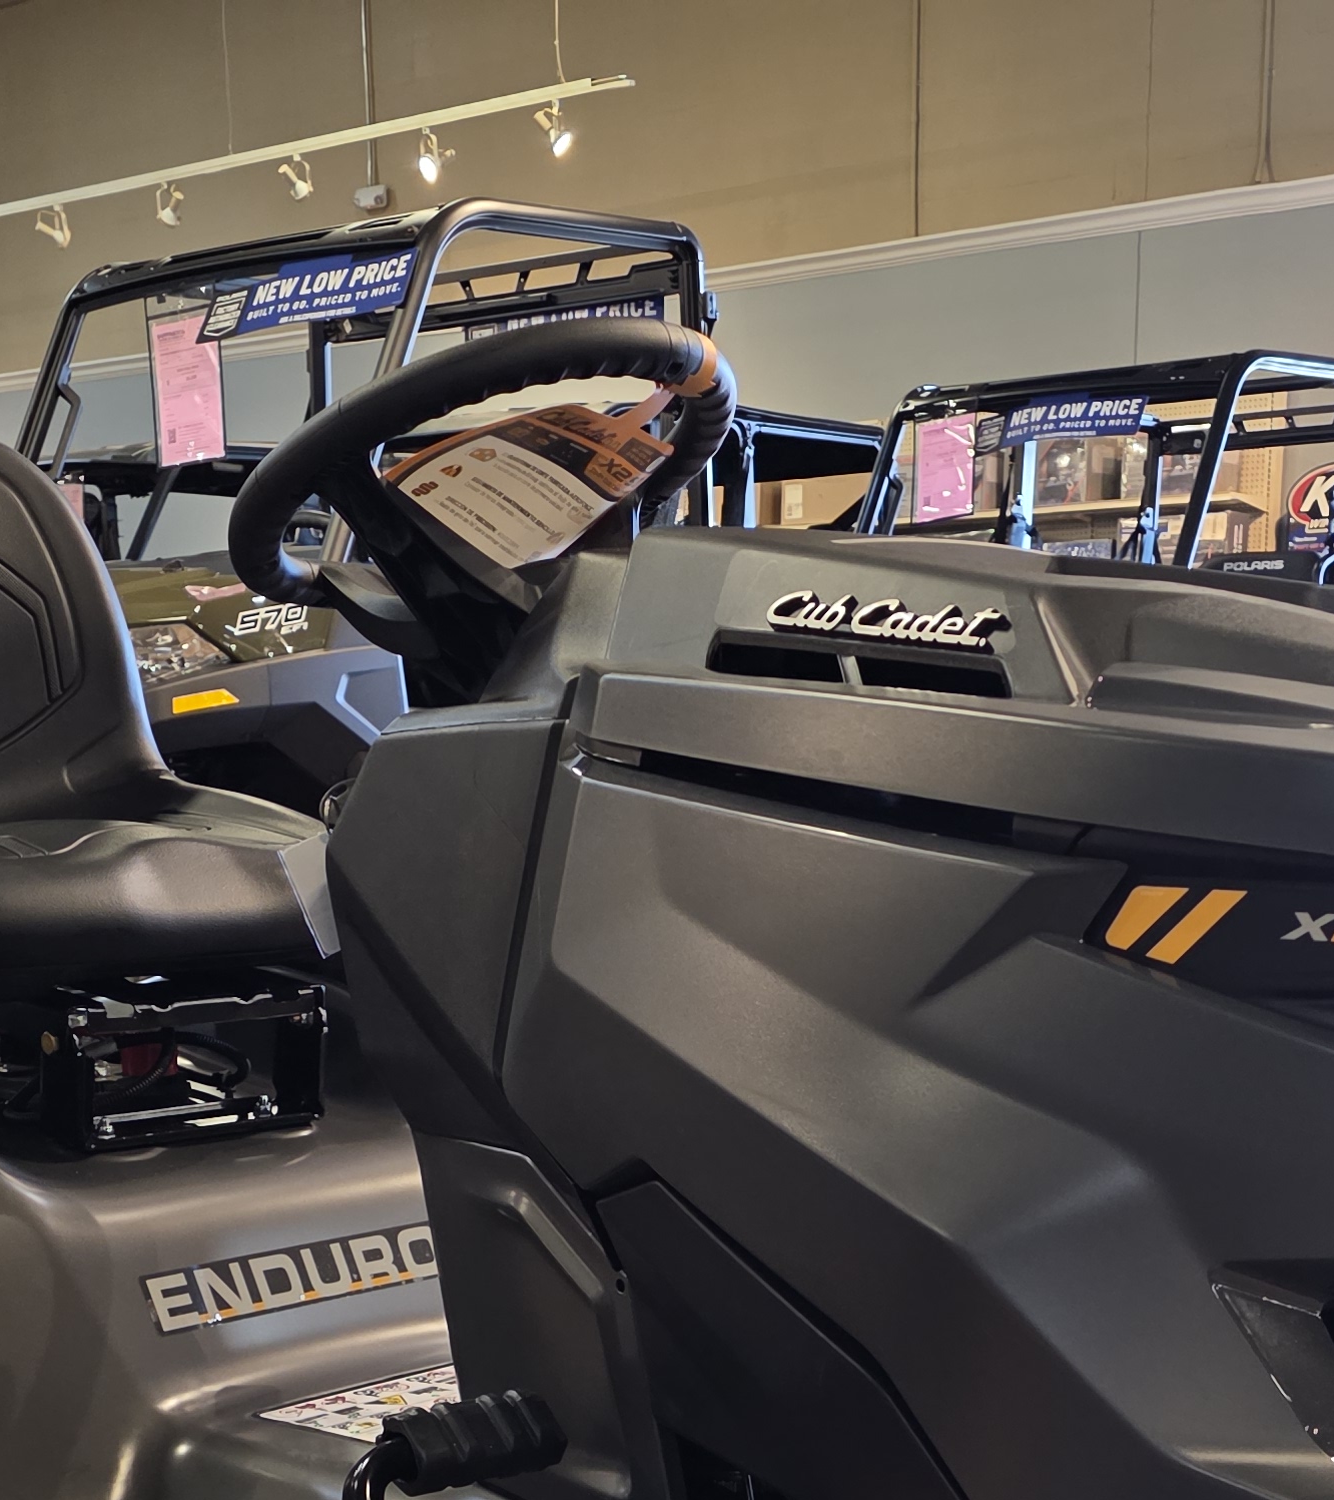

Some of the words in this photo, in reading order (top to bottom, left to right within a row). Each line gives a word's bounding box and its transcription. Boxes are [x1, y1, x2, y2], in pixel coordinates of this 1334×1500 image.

[252, 276, 300, 306] NEW
[299, 268, 349, 296] LOW
[349, 254, 413, 288] PRICE
[246, 305, 275, 321] BUILT
[277, 302, 290, 313] TO
[312, 293, 352, 308] PRICED
[355, 290, 369, 301] TO
[1010, 406, 1047, 428] NEW
[1047, 402, 1088, 420] LOW
[1088, 398, 1143, 417] PRICE
[1030, 424, 1041, 432] TO
[1059, 420, 1092, 429] PRICED
[1094, 419, 1106, 427] TO
[1223, 560, 1285, 571] POLARIS
[233, 603, 308, 636] 570
[766, 589, 855, 632] Cub
[146, 1225, 439, 1332] ENDURO
